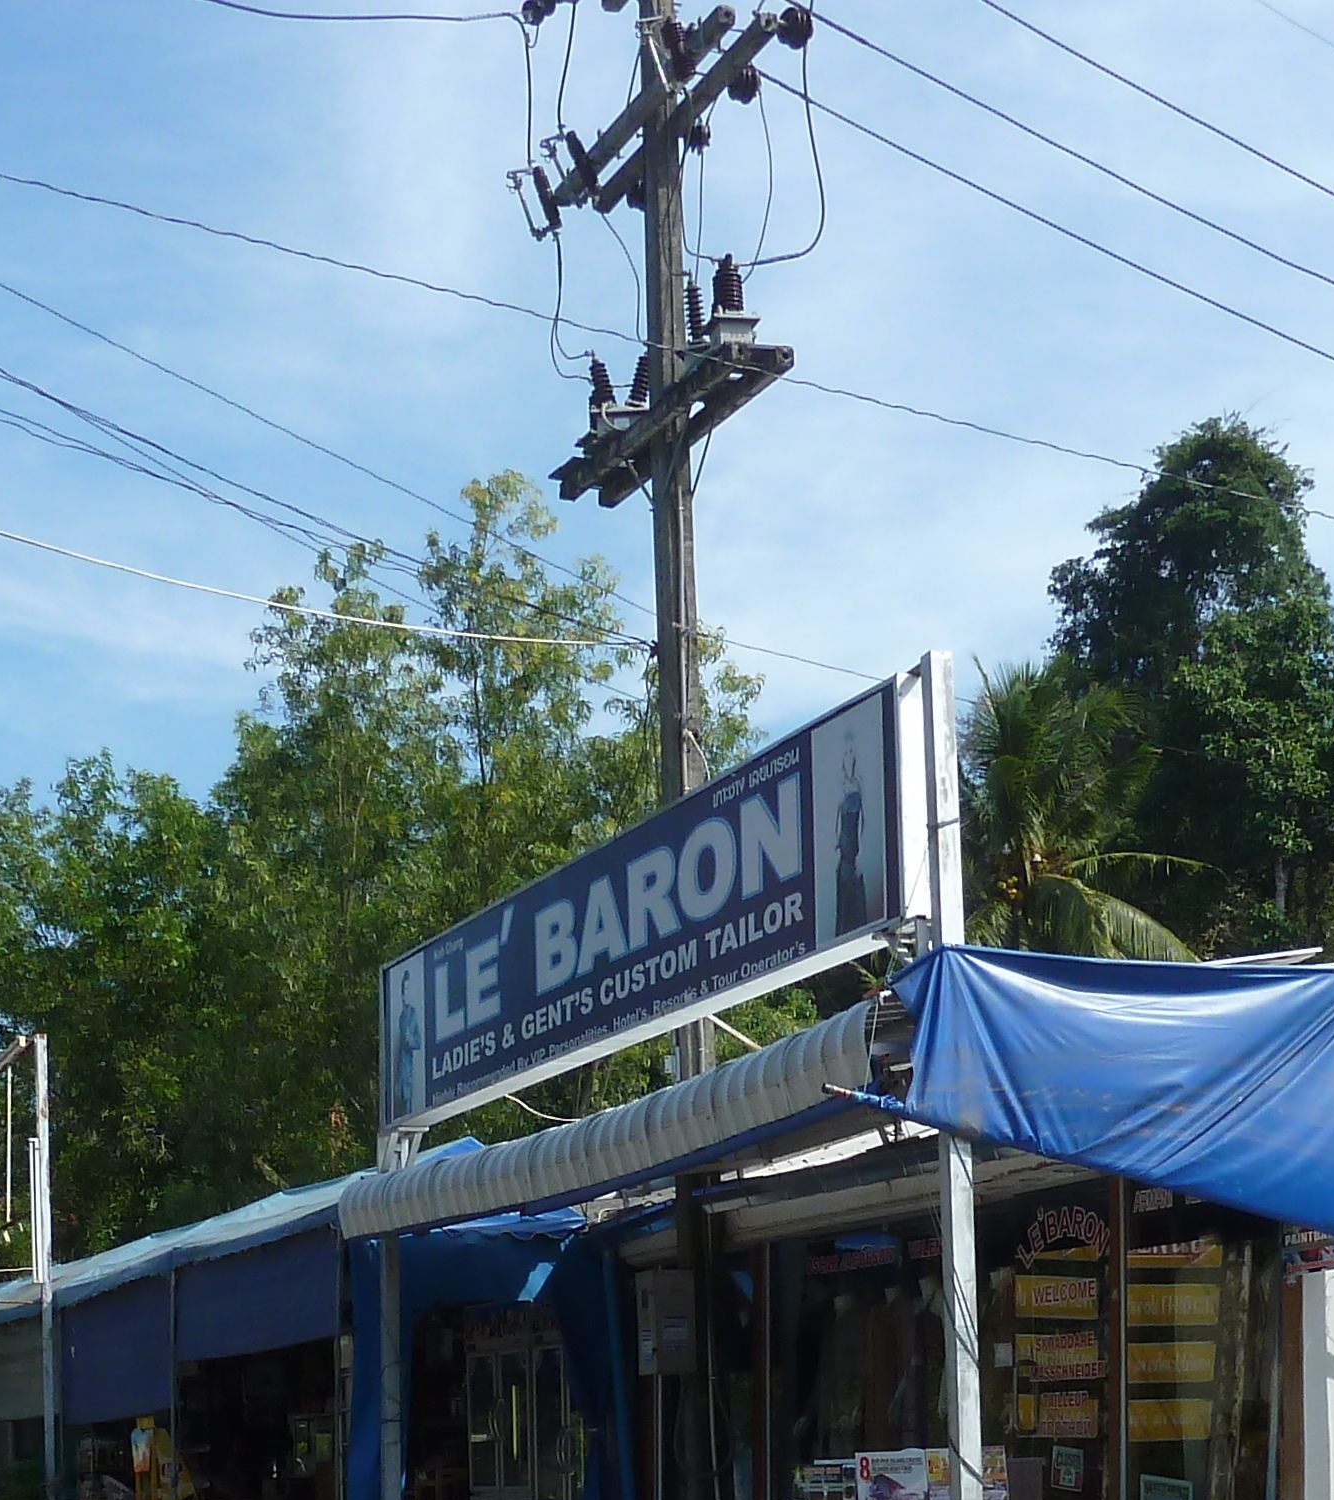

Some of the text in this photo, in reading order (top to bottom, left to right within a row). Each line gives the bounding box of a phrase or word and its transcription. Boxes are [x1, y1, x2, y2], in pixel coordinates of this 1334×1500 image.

[534, 772, 802, 998] BARON
[432, 892, 804, 1080] LADIE'S & GENT'S CUSTOM TAILOR
[456, 1060, 516, 1094] Recommended
[652, 985, 698, 1015] Resort's
[700, 979, 709, 995] &
[711, 970, 738, 990] Tour
[740, 940, 806, 978] Operator's
[1032, 1279, 1097, 1307] WELCOME
[860, 1456, 870, 1481] 8
